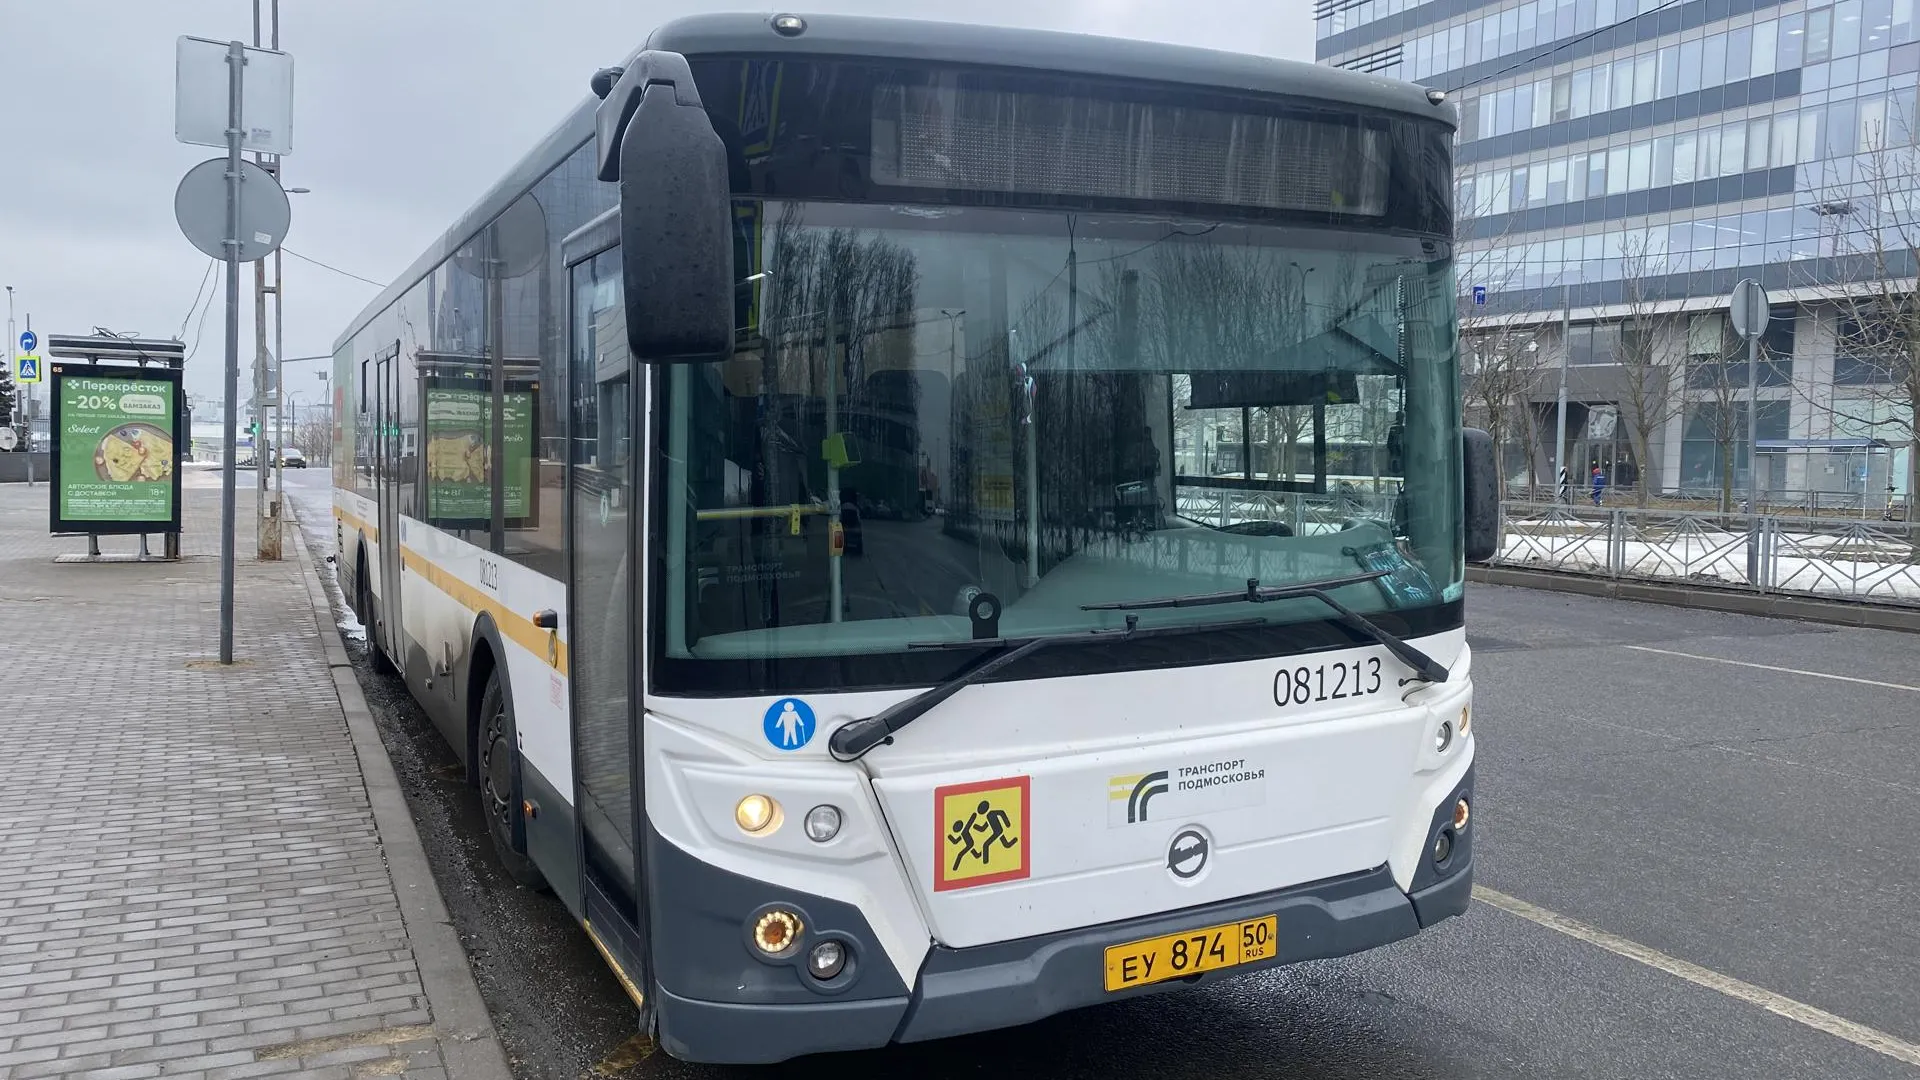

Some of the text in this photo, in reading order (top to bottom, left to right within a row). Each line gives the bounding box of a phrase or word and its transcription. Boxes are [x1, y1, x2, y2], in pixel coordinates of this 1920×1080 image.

[82, 380, 166, 393] Перекрёсток
[67, 424, 100, 434] Select
[150, 488, 165, 496] 18+
[1273, 656, 1381, 707] 081213
[1178, 759, 1246, 778] ТРАНСПОРТ
[1178, 769, 1265, 791] ПОДМОСКОВЬЯ
[1243, 922, 1268, 948] 50
[1171, 932, 1226, 971] 874
[1245, 946, 1265, 959] RUS
